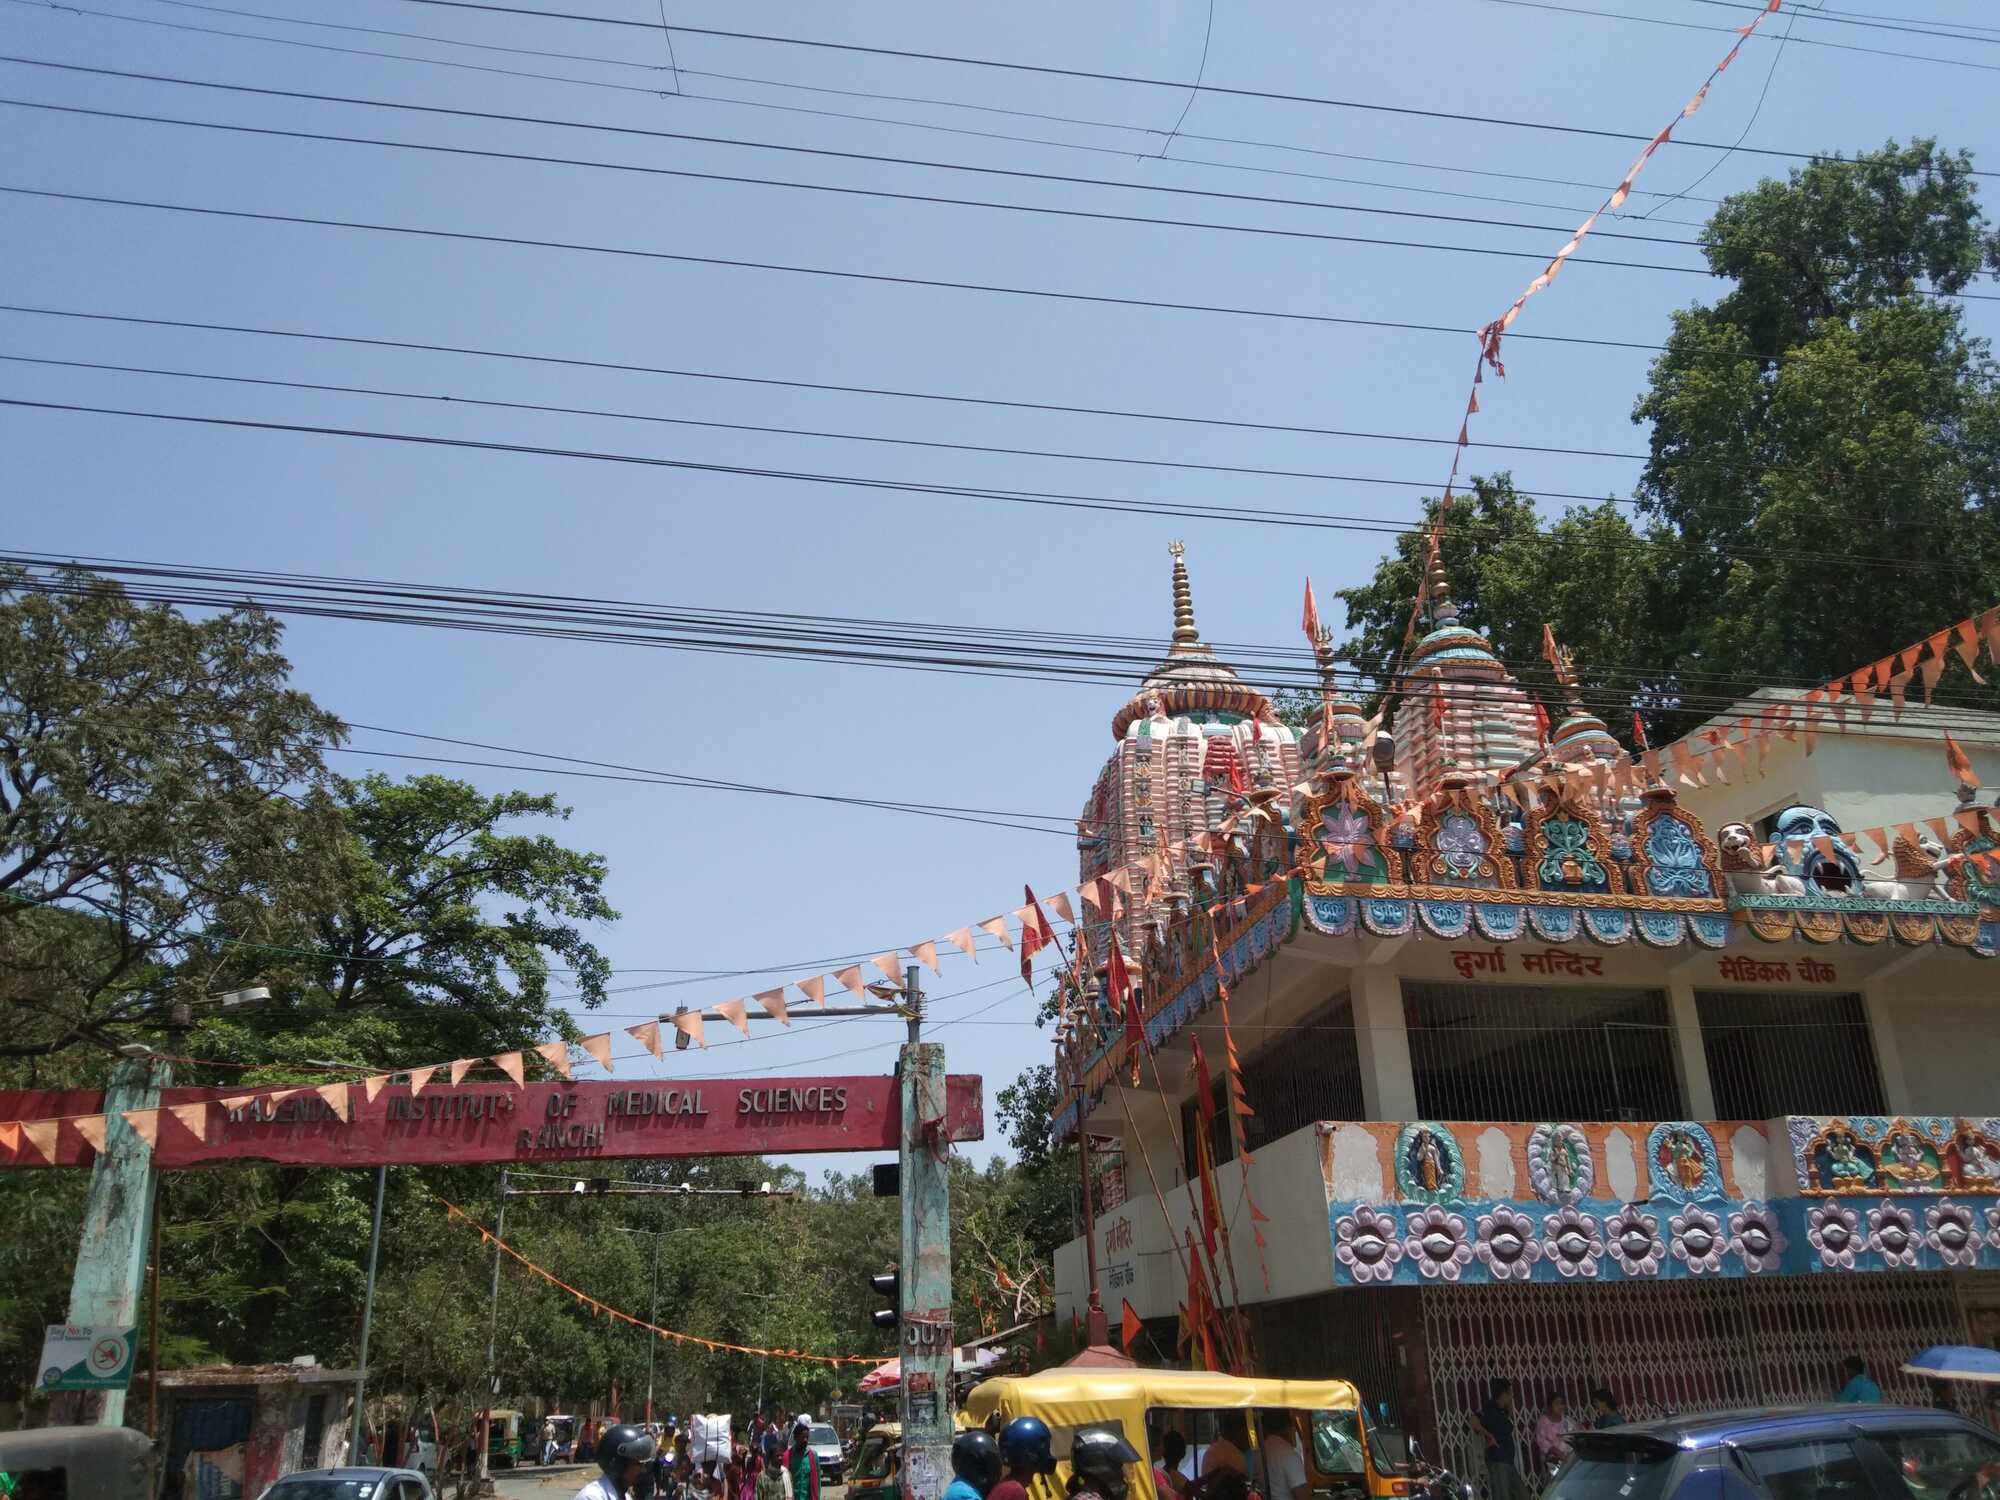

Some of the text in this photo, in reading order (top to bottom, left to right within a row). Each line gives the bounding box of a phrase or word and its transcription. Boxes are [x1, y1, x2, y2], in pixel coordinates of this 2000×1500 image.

[1450, 946, 1603, 978] दुर्गा मन्दिर
[549, 1092, 577, 1117] OF
[607, 1088, 709, 1116] MEDICAL
[738, 1086, 848, 1113] SCIENCES
[518, 1121, 605, 1149] RANCHI
